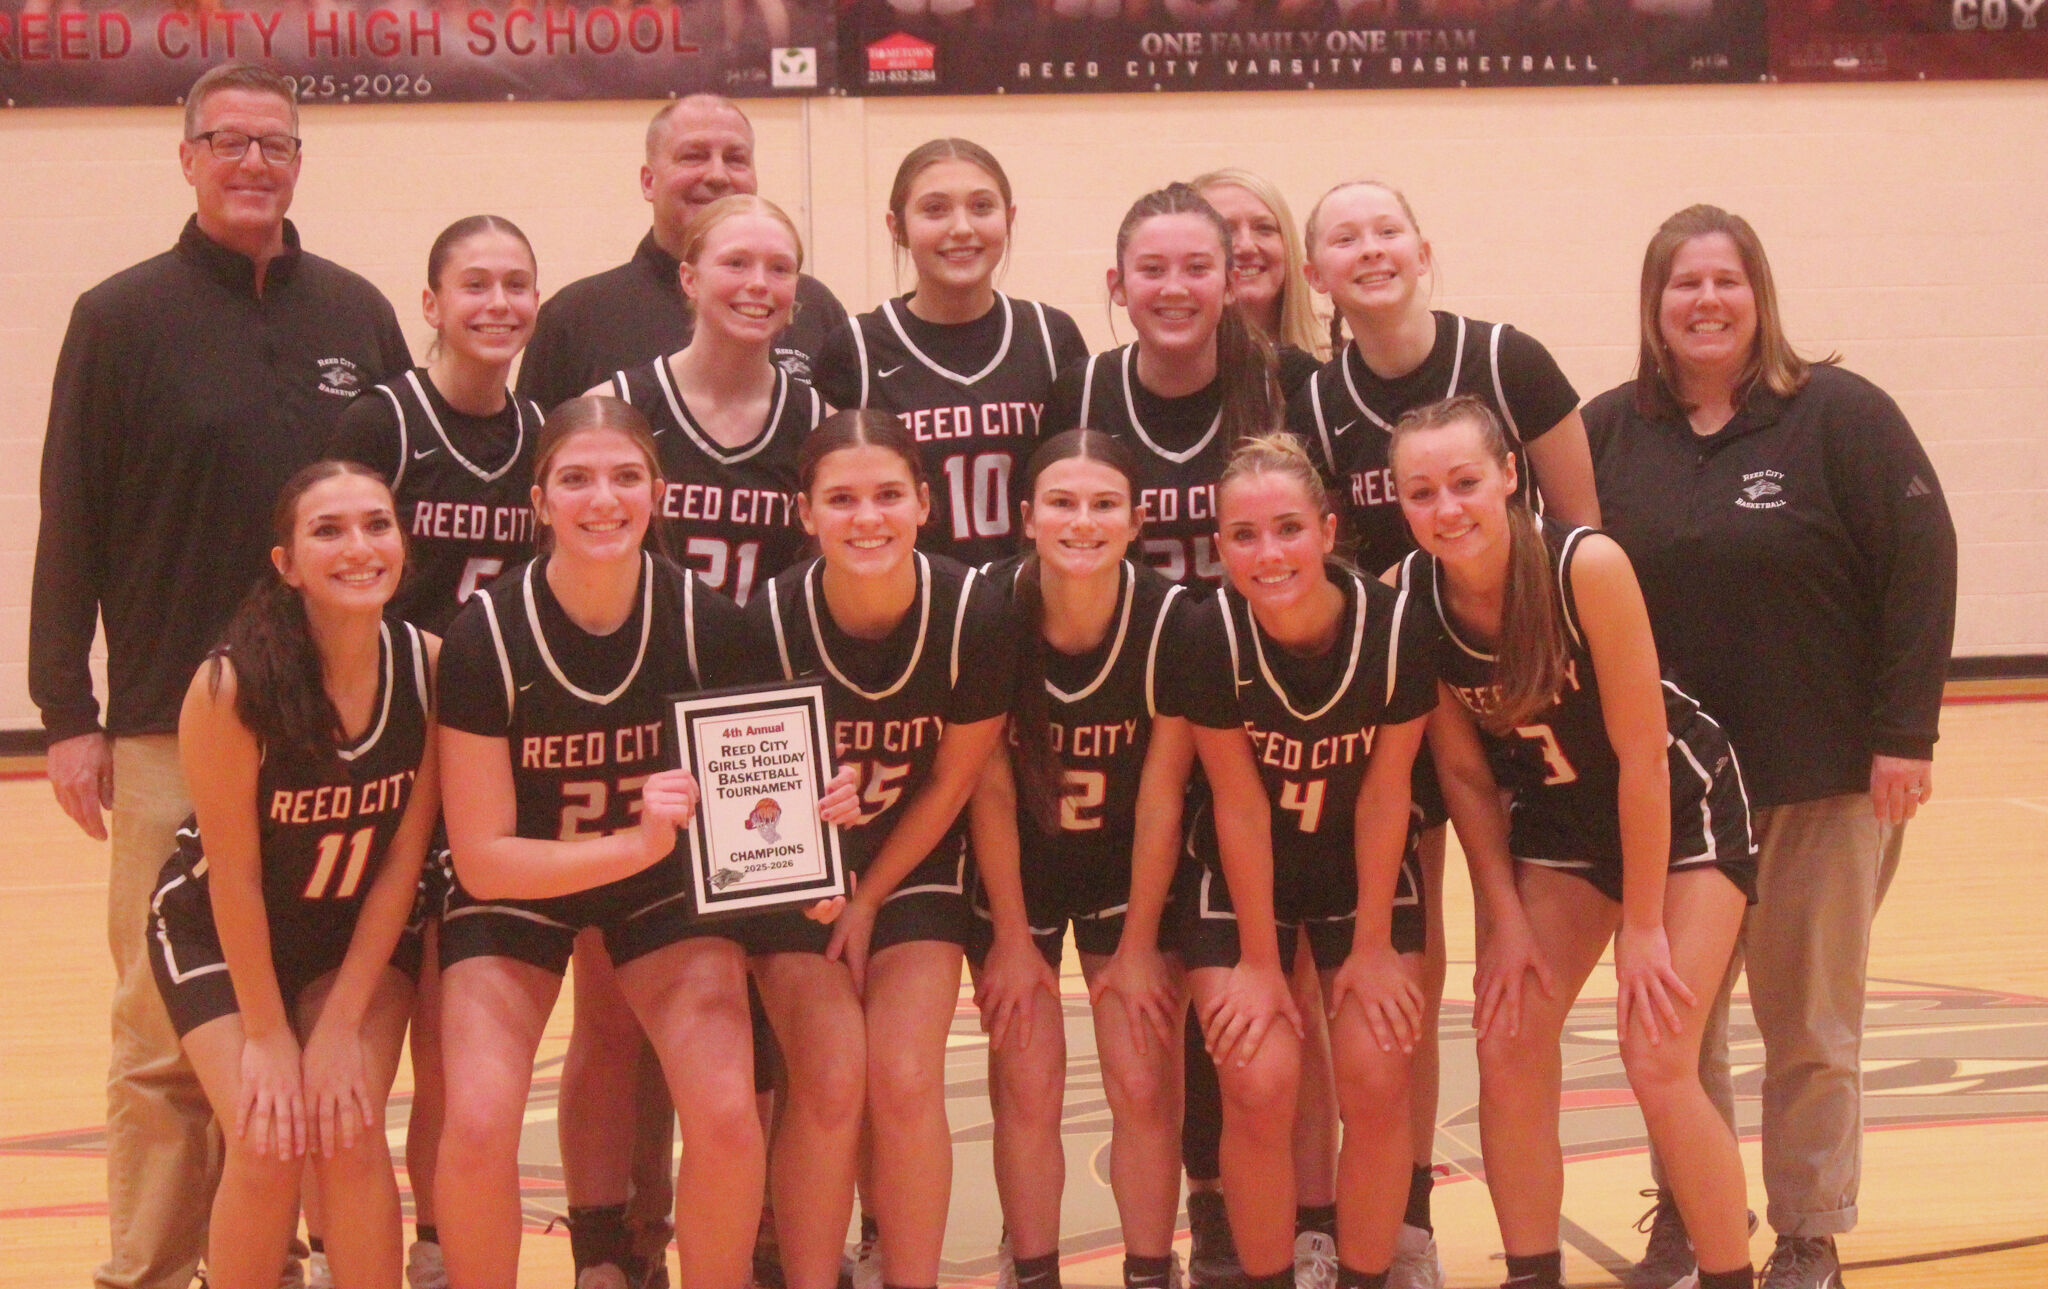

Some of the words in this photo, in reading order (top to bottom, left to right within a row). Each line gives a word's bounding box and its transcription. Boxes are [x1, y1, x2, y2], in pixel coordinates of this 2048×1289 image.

[0, 12, 132, 60] REED
[157, 11, 283, 59] CITY
[307, 9, 441, 58] HIGH
[467, 6, 699, 56] SCHOOL
[1141, 32, 1201, 54] ONE
[1210, 31, 1319, 54] FAMILY
[1326, 30, 1386, 52] ONE
[1394, 29, 1476, 51] TEAM
[1018, 61, 1099, 77] REED
[1126, 60, 1199, 76] CITY
[1226, 58, 1363, 75] VARSITY
[1390, 55, 1598, 73] BASKETBALL
[283, 74, 432, 97] 025-2026
[981, 402, 1045, 437] CITY
[1350, 468, 1398, 506] REE
[1742, 471, 1764, 481] REED
[1765, 469, 1785, 479] CITY
[662, 483, 723, 521] EED
[730, 488, 797, 527] CITY
[943, 452, 1015, 541] 10
[1140, 487, 1178, 523] ED
[1188, 484, 1217, 520] CI
[1735, 497, 1787, 509] BASKETBALL
[412, 501, 489, 540] REED
[521, 731, 606, 769] REED
[615, 720, 663, 764] CIT
[722, 728, 743, 739] 4th
[746, 722, 785, 737] Annual
[835, 720, 873, 751] ED
[1073, 717, 1138, 757] CITY
[1311, 726, 1377, 770] CITY
[708, 759, 748, 773] GIRLS
[752, 752, 806, 768] HOLIDAY
[721, 744, 756, 758] REED
[760, 740, 789, 753] CITY
[1514, 723, 1578, 786] 3
[716, 779, 803, 799] TOURNAMENT
[718, 767, 799, 786] BASKETBALL
[270, 786, 352, 823] REED
[1059, 769, 1107, 832] 2
[1279, 777, 1328, 834] 4
[303, 825, 377, 899] 11
[729, 843, 806, 863] CHAMPIONS
[744, 859, 795, 873] 2025-2026
